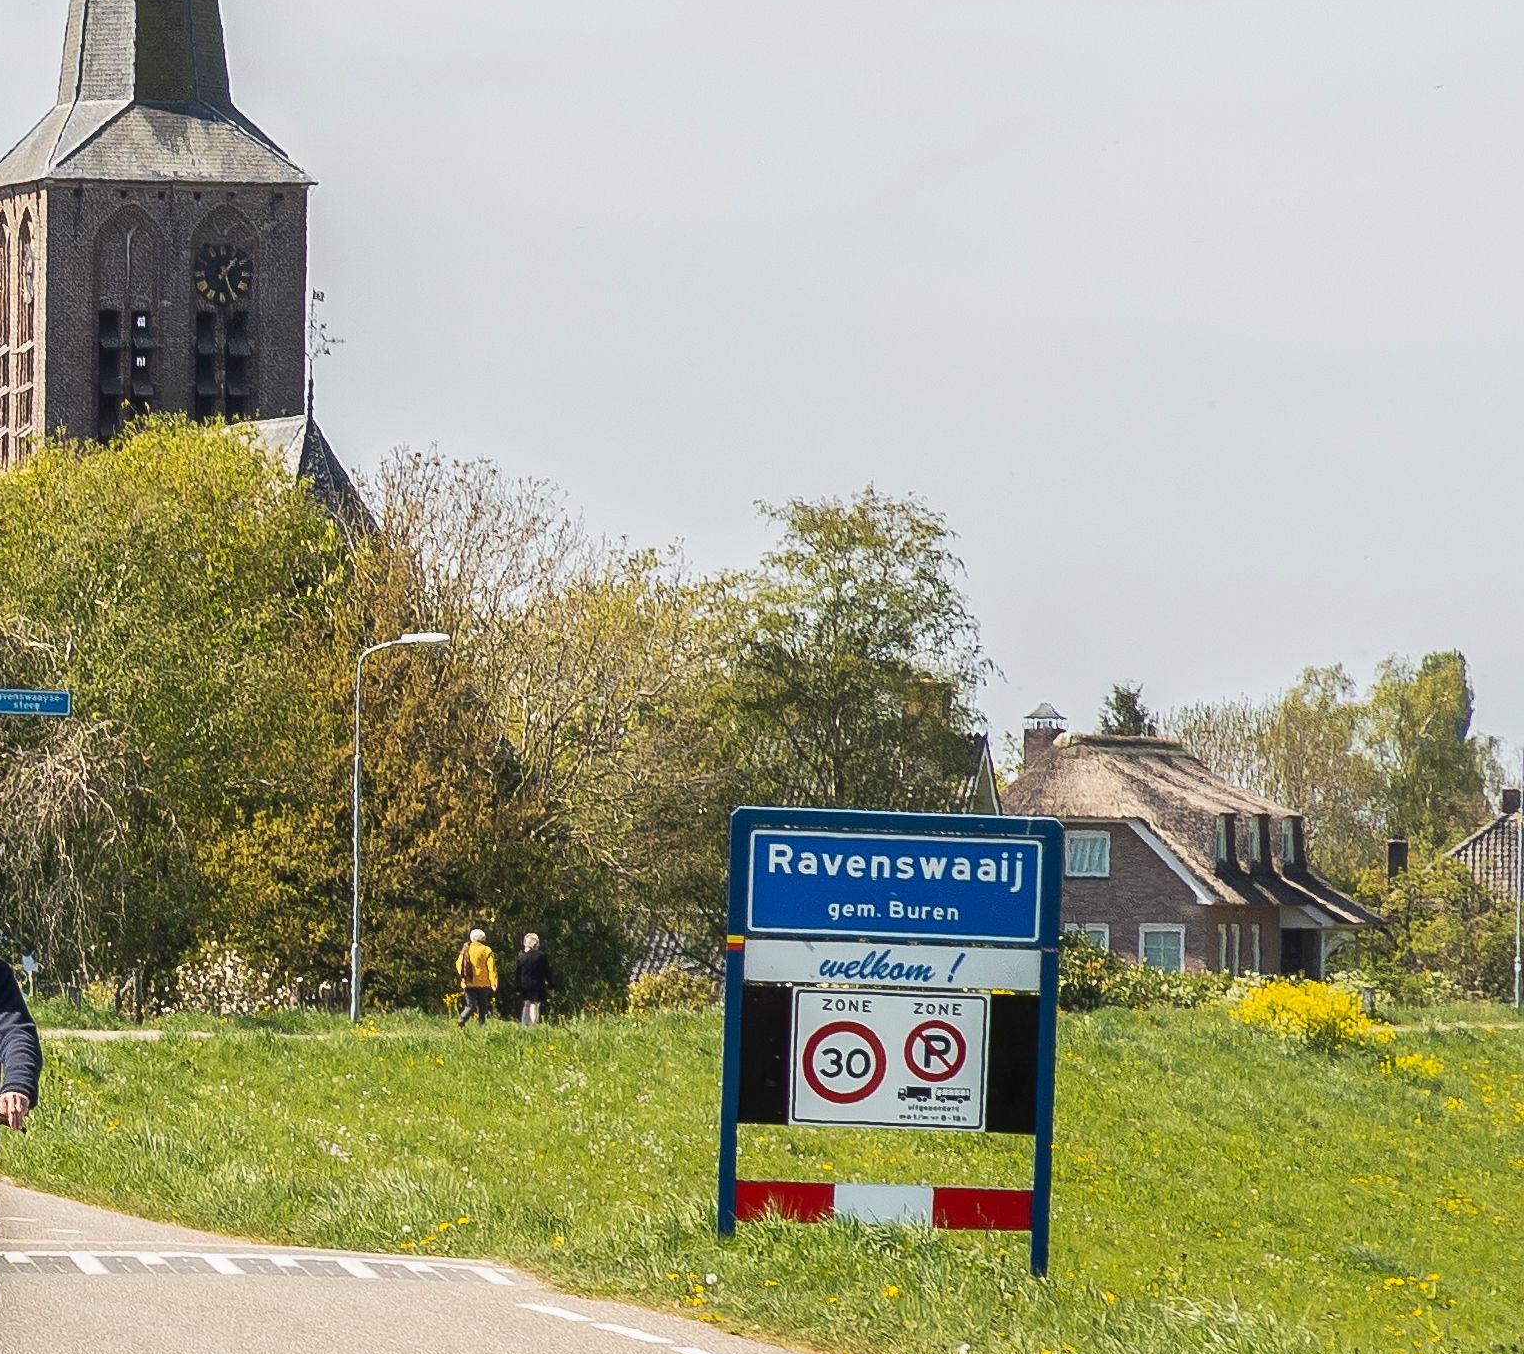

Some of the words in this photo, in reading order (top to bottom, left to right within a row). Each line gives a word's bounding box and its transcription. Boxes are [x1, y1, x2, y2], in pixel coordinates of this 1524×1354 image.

[768, 843, 1024, 893] Ravenswaaij
[827, 902, 881, 921] gem.
[889, 900, 959, 921] Buren
[818, 949, 936, 982] welkom
[821, 998, 873, 1013] ZONE
[913, 1002, 963, 1017] ZONE
[819, 1047, 871, 1079] 30
